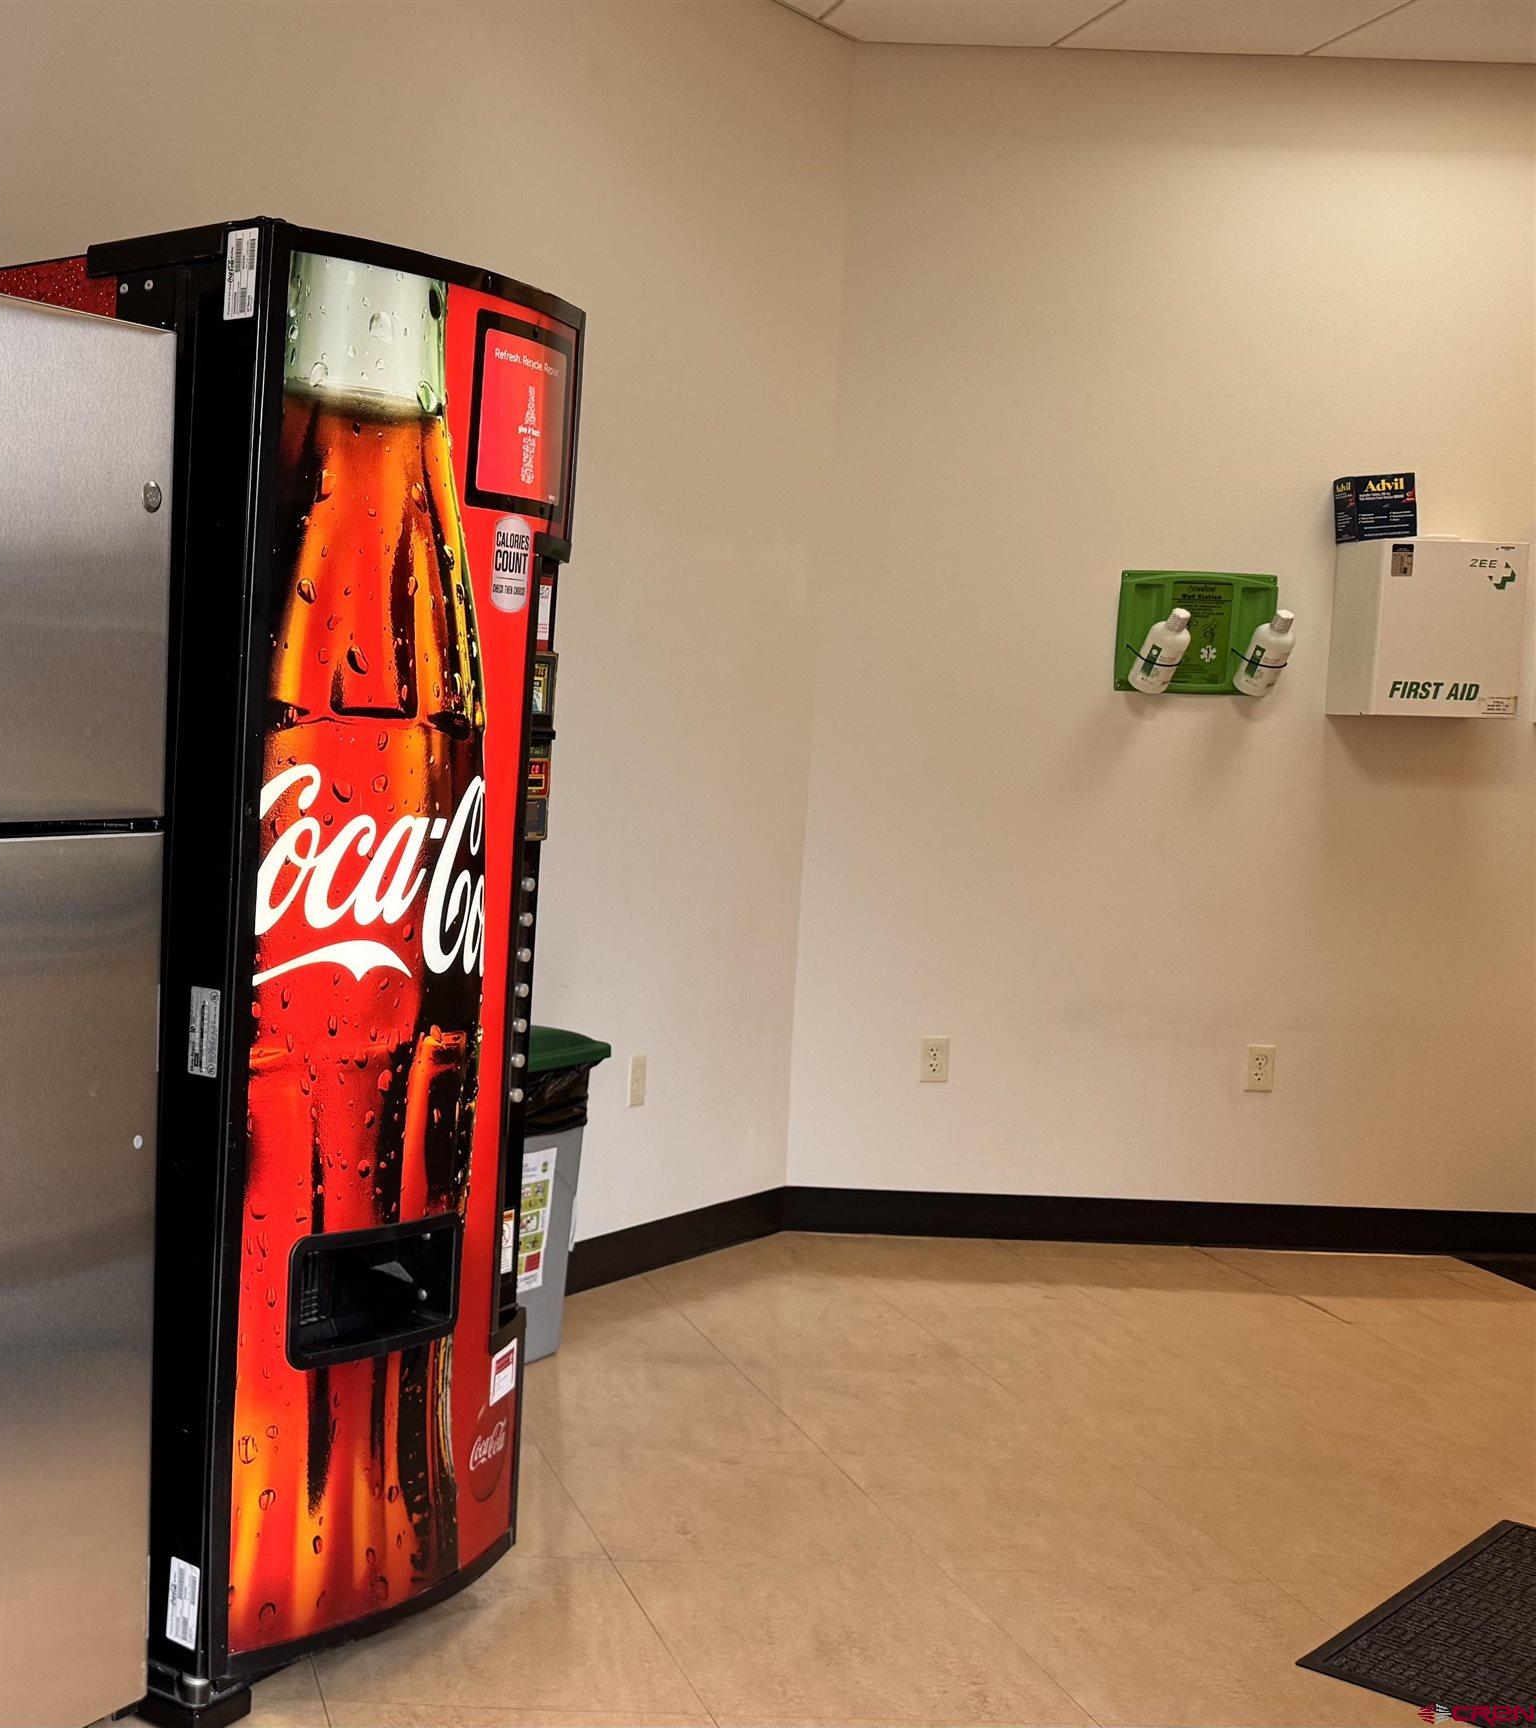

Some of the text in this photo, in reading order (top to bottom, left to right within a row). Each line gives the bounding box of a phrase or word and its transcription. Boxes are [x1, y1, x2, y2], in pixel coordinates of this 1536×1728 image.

[494, 348, 522, 364] Refresh.
[1364, 477, 1405, 493] Advil
[496, 531, 530, 551] CALORIES
[494, 550, 529, 574] COUNT
[1469, 558, 1498, 569] ZEE
[1388, 680, 1481, 701] FIRST AID
